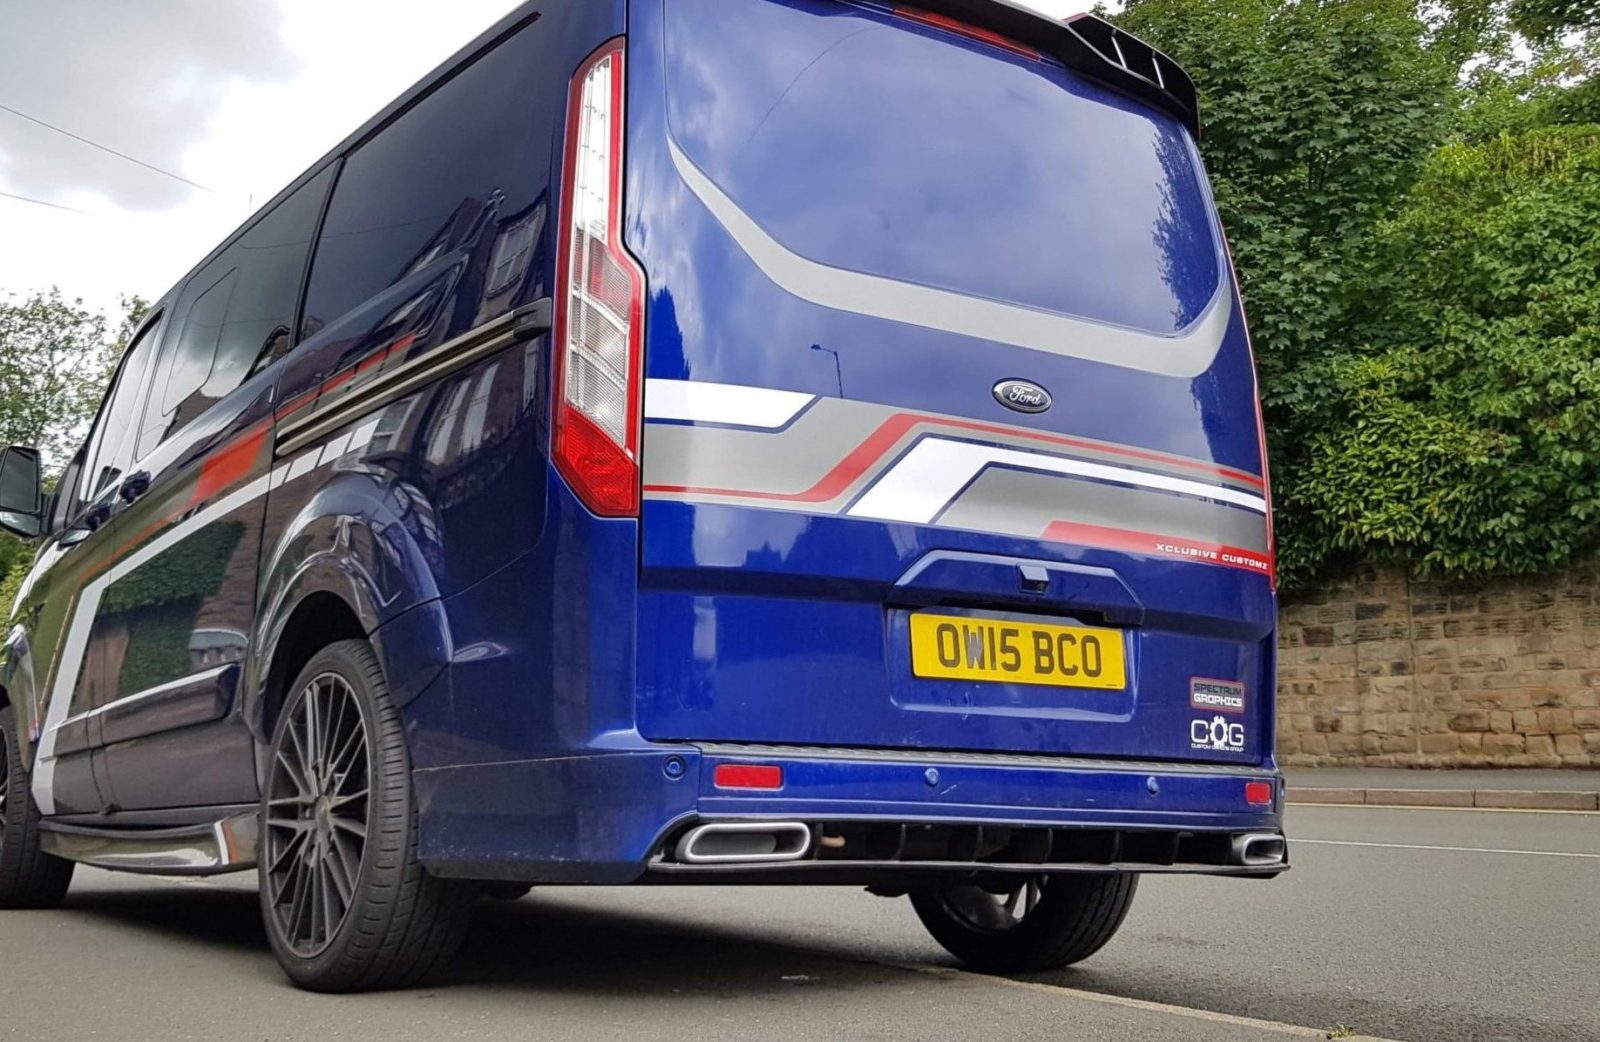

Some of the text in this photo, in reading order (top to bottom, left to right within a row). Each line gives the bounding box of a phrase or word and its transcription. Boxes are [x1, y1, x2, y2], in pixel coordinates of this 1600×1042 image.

[1009, 385, 1041, 405] Ford
[1155, 543, 1268, 570] XCLUSIVE CUSTOMZ
[936, 623, 1102, 678] OW15 BCO
[1194, 682, 1241, 695] SPECTRUM
